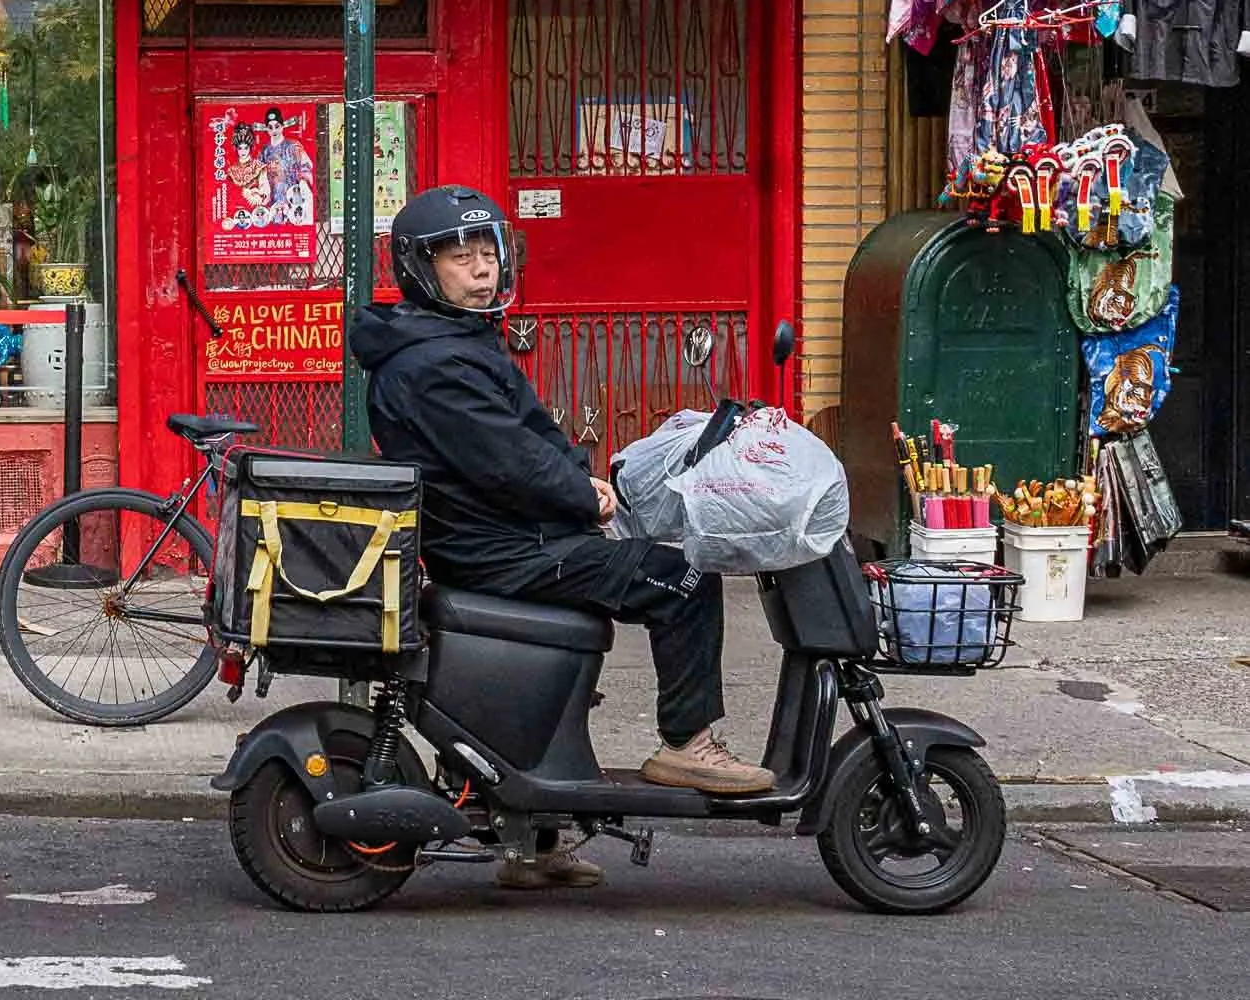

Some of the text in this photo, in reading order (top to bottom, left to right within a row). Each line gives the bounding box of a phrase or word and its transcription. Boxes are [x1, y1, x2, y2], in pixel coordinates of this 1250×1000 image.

[232, 305, 246, 324] A
[250, 304, 295, 324] LOVE
[228, 327, 245, 340] TO
